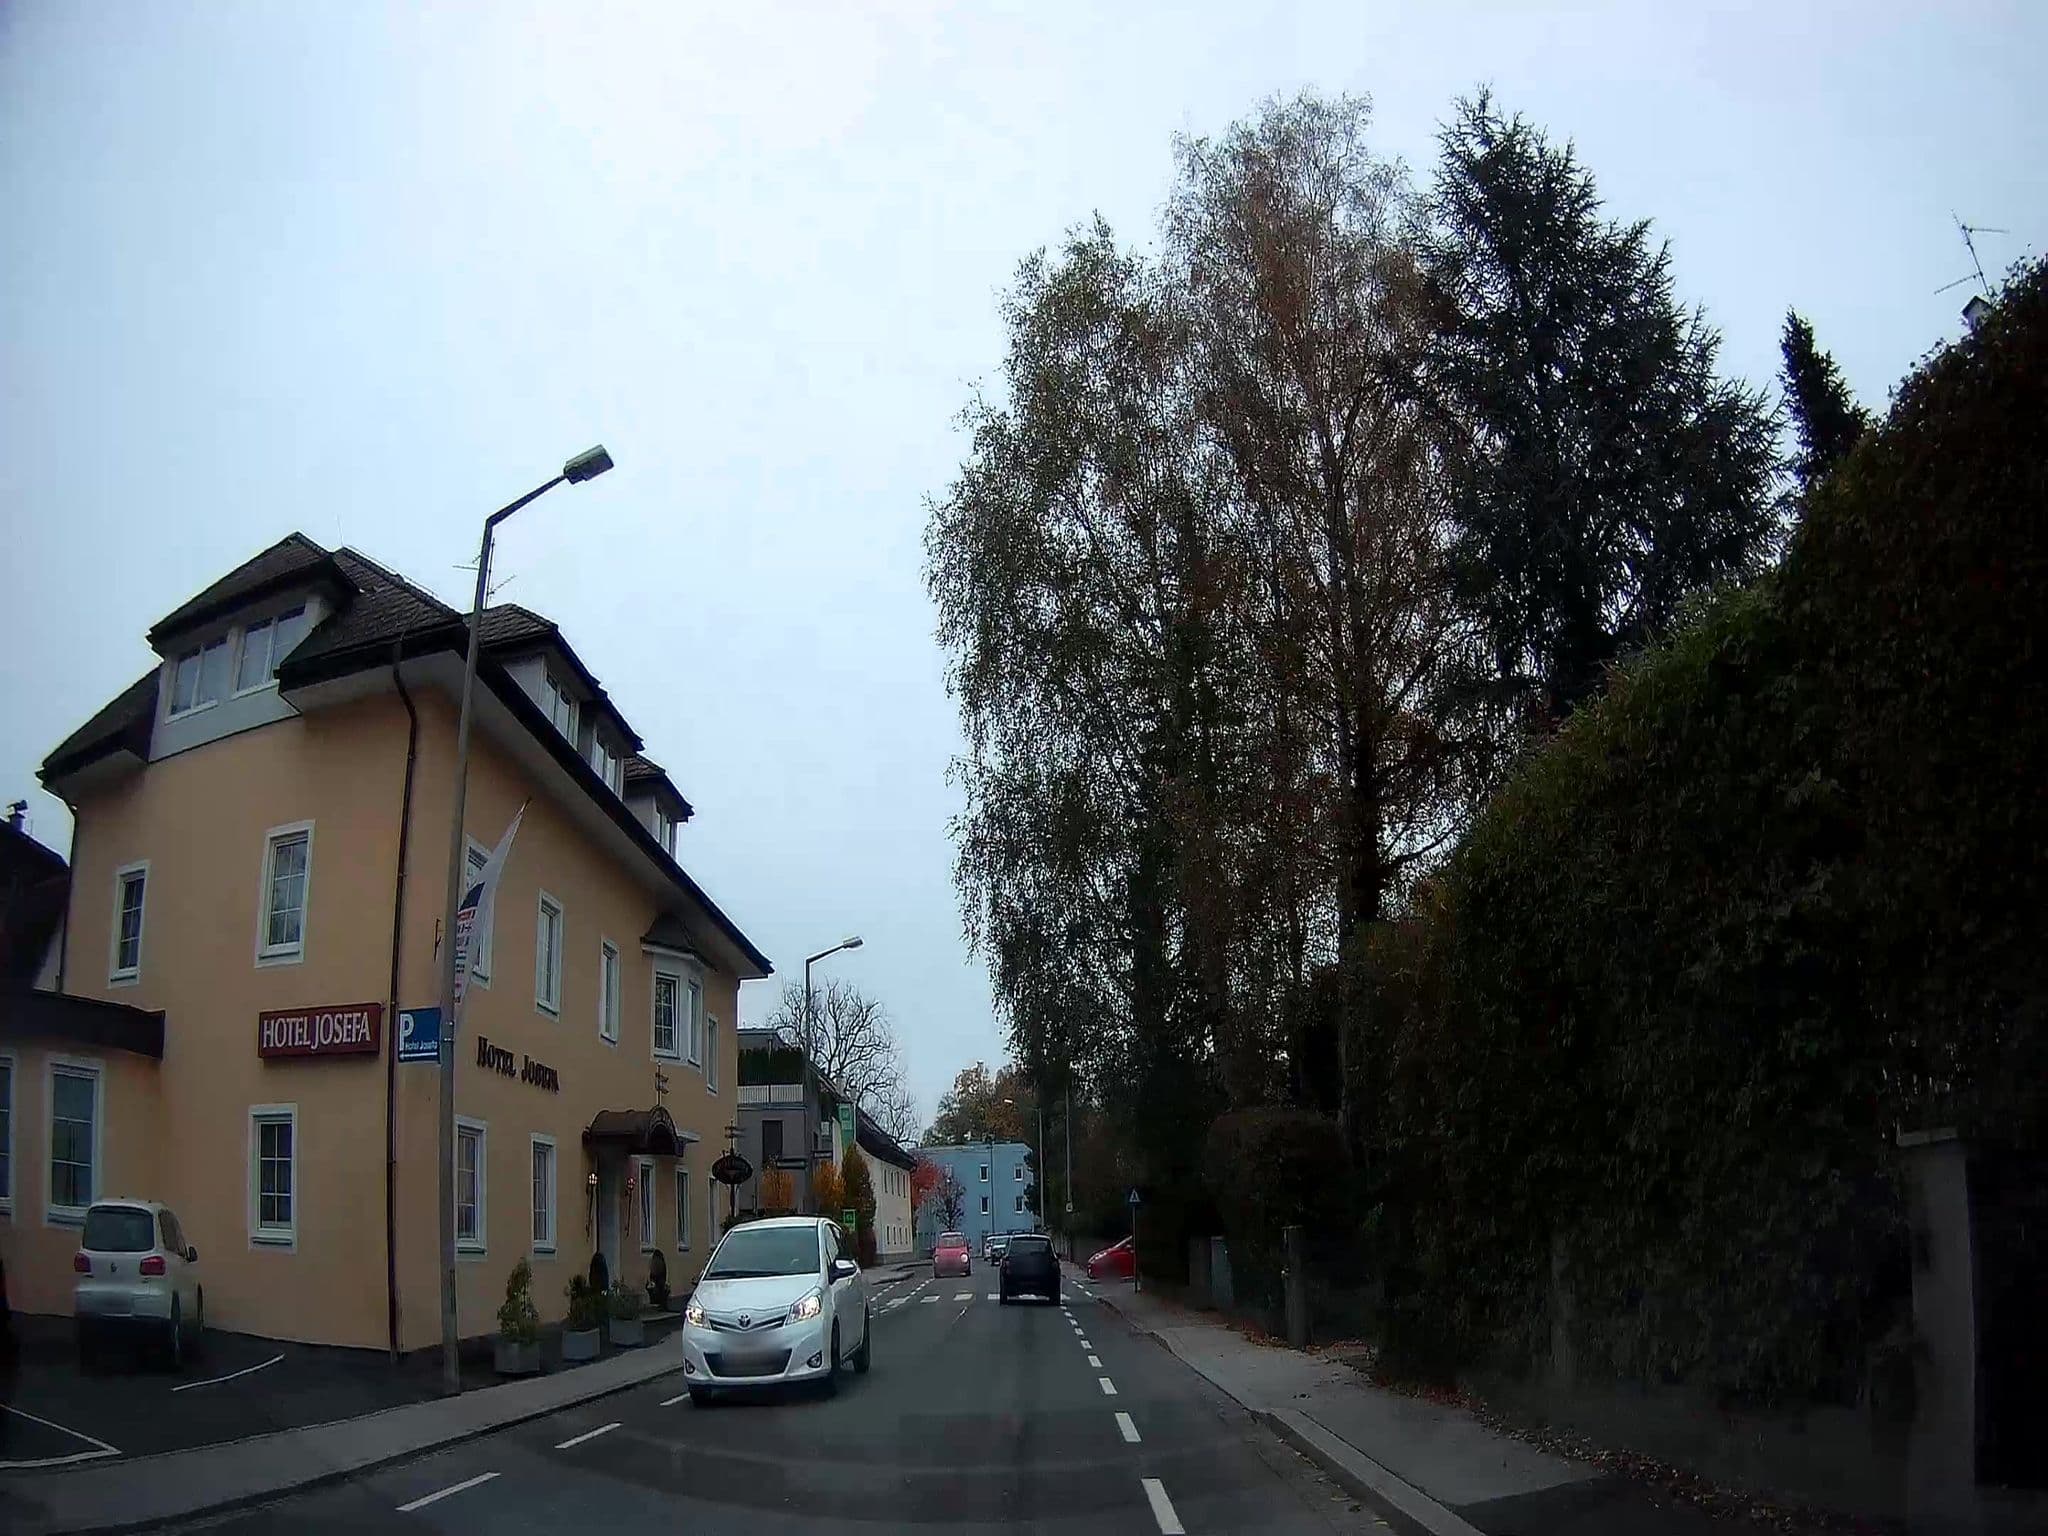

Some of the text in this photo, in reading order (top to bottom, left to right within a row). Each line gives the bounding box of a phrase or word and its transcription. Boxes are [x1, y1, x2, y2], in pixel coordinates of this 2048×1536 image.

[263, 1011, 370, 1050] HOTEL JOSEFA
[399, 1013, 415, 1051] P
